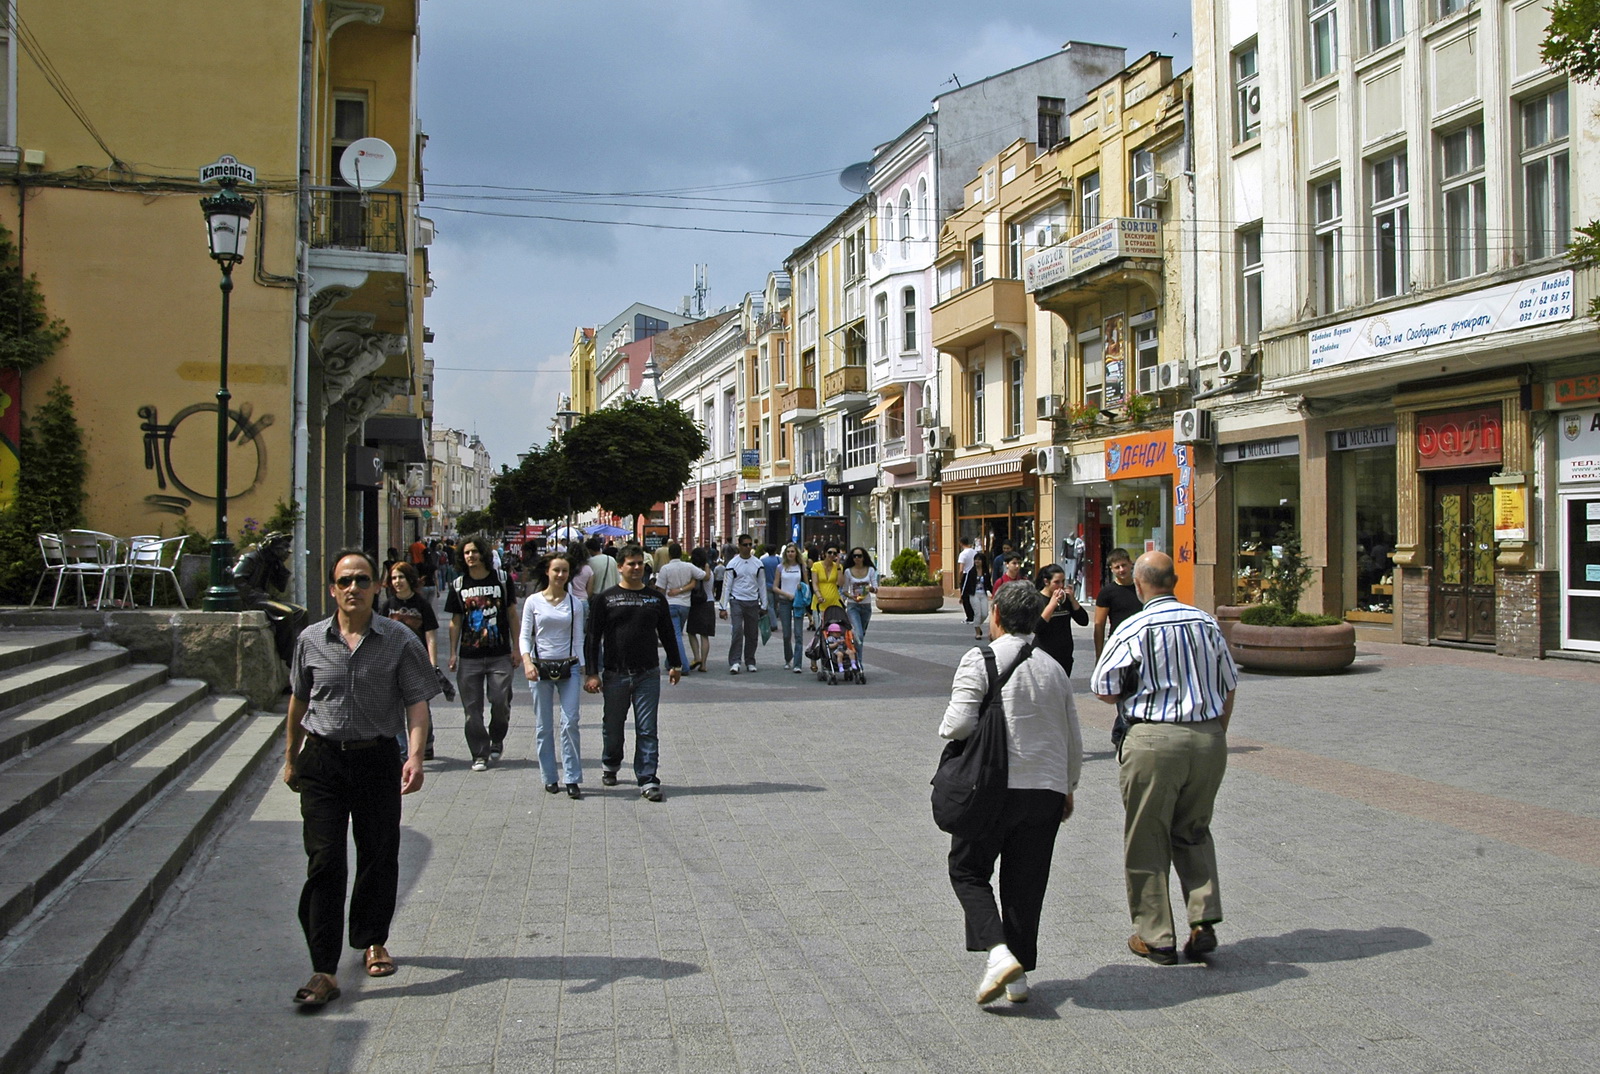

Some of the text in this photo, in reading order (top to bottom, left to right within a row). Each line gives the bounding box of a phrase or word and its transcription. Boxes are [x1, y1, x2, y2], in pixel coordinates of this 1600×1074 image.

[202, 164, 253, 182] Kamenitza
[1120, 220, 1158, 233] SORTUR
[1037, 249, 1064, 268] SORTUR
[1541, 276, 1570, 291] Пловдив
[1519, 300, 1531, 309] 032
[1539, 295, 1548, 305] 62
[1549, 293, 1559, 303] 88
[1561, 291, 1570, 301] 57
[1519, 312, 1532, 322] 032
[1549, 306, 1559, 316] 88
[1561, 304, 1570, 314] 75
[1393, 333, 1403, 343] на
[1350, 427, 1391, 446] MURATTI
[1121, 441, 1167, 471] ДЕНДИ
[1247, 441, 1280, 457] MURATTI
[409, 496, 430, 506] GSM
[460, 585, 502, 602] PANTERA
